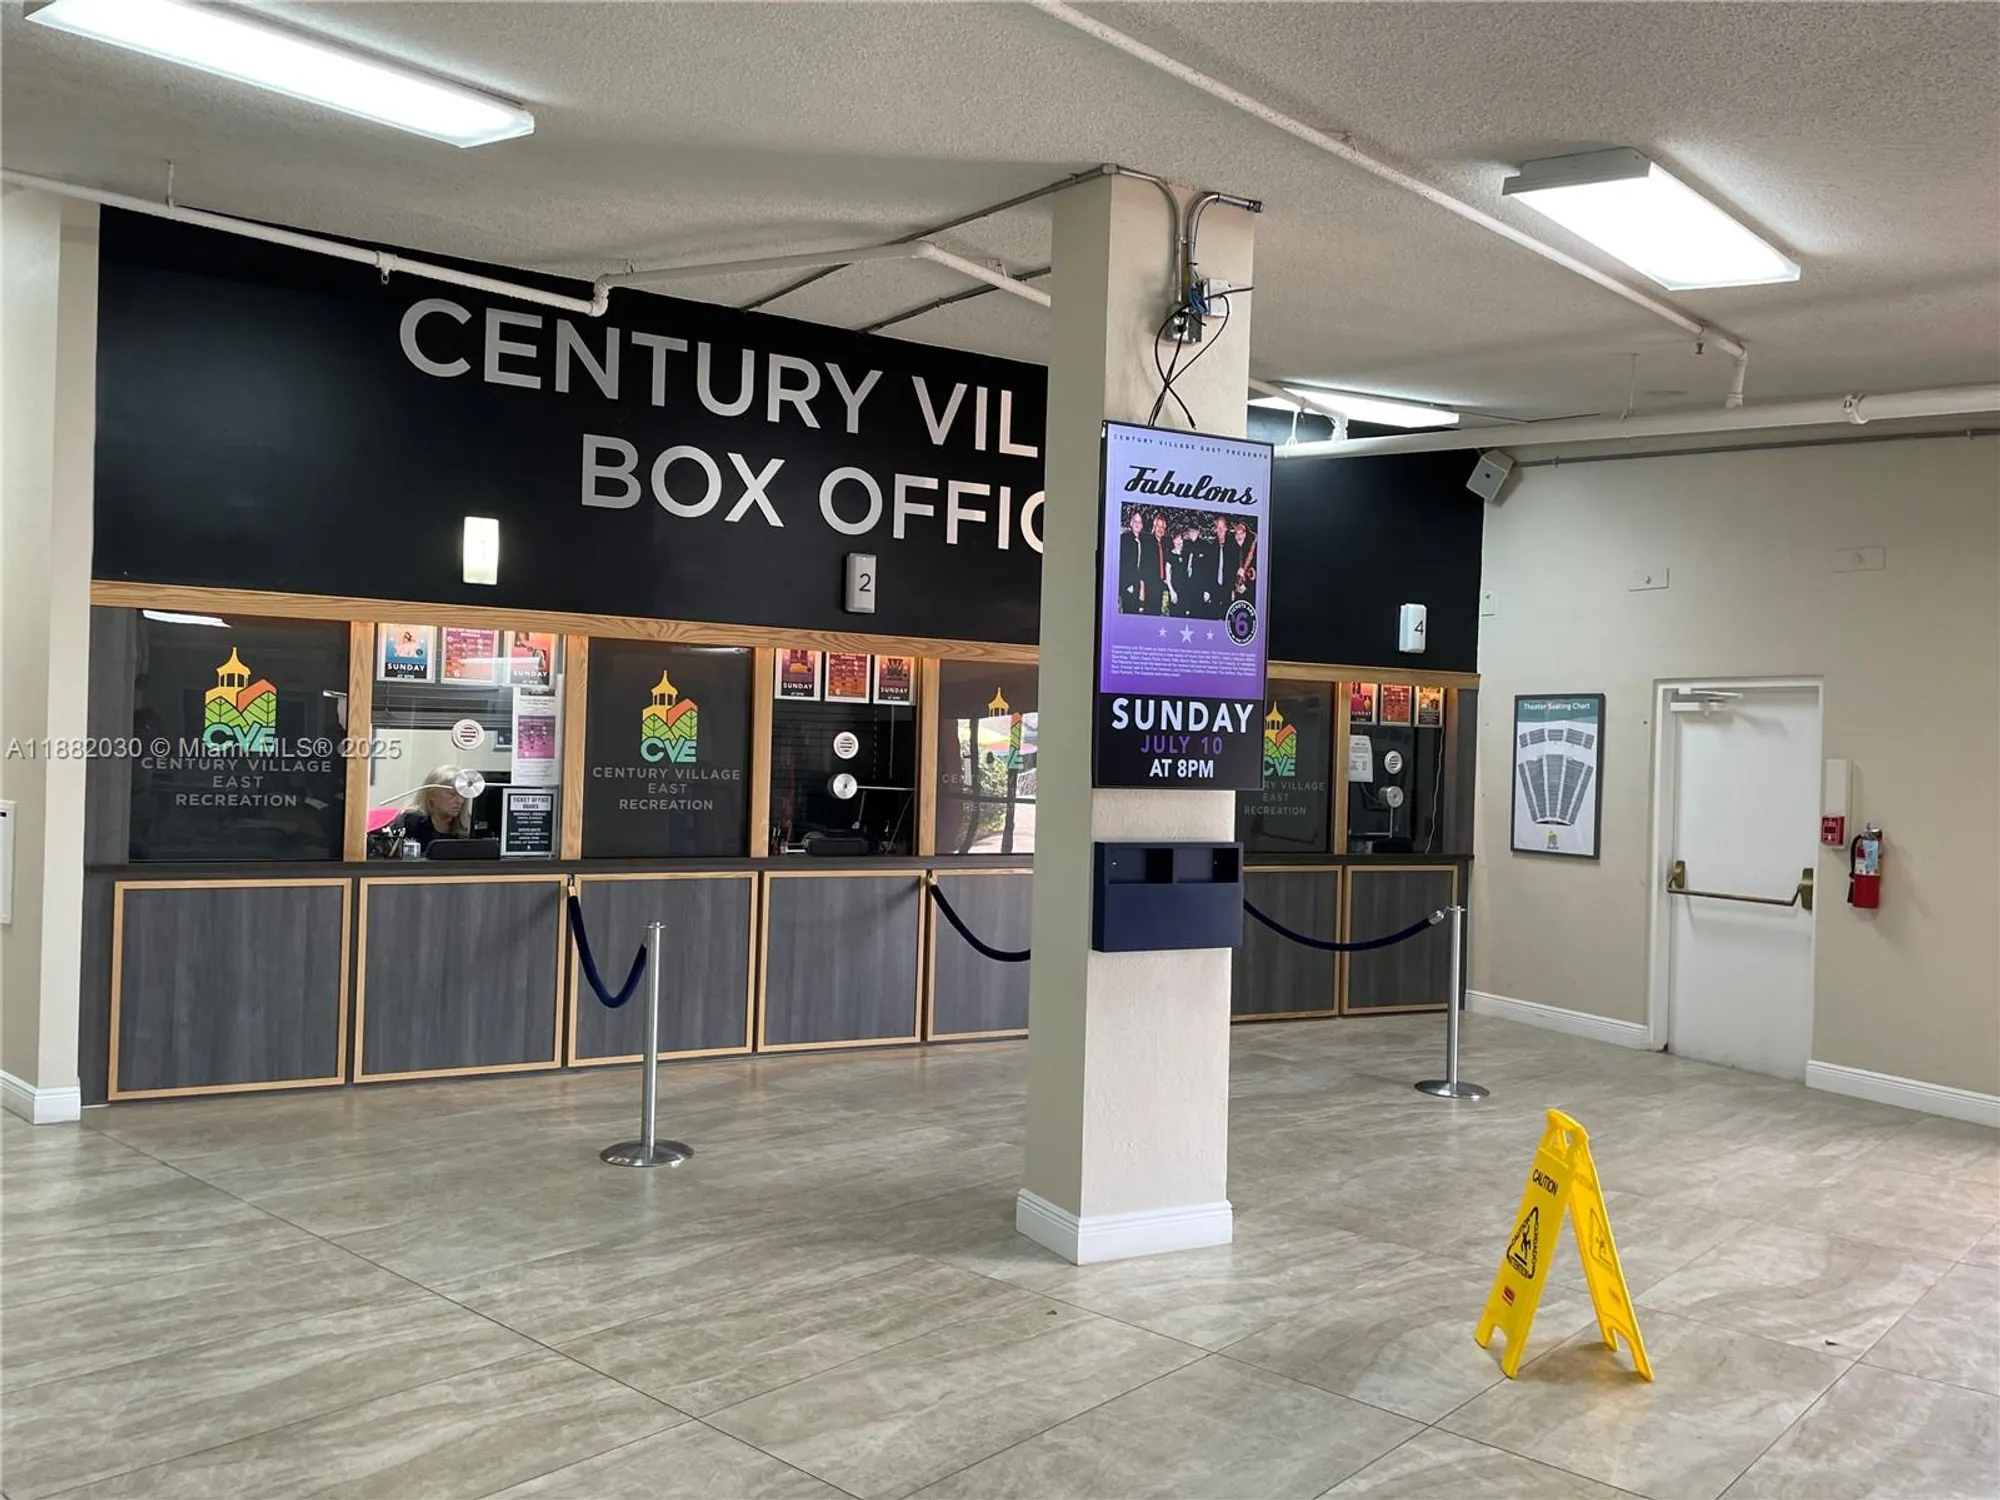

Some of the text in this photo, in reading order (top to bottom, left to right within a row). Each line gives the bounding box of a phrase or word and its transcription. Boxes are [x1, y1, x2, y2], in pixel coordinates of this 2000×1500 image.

[398, 297, 1039, 458] CENTURY VIL
[1158, 440, 1197, 451] VILLAGE
[1200, 445, 1221, 453] EAST
[1124, 465, 1257, 505] Fabulons
[581, 433, 1047, 556] BOX OFFIC
[859, 573, 871, 593] 2
[1414, 620, 1424, 636] 4
[387, 662, 425, 672] SUNDAY
[512, 669, 549, 678] SUNDAY
[783, 682, 813, 690] SUNDAY
[880, 686, 908, 694] SUNDAY
[1547, 703, 1571, 711] Seating
[1573, 702, 1590, 710] Chart
[1112, 697, 1254, 733] SUNDAY
[202, 721, 275, 753] CVE
[640, 736, 698, 763] CVE
[1141, 734, 1223, 756] JULY 10
[141, 756, 332, 773] CENTURY VILLAGE
[1149, 759, 1214, 779] AT 8PM
[1264, 754, 1296, 777] CVE
[592, 766, 741, 780] CENTURY VILLAGE
[213, 776, 264, 789] EAST
[647, 782, 688, 794] EAST
[1281, 781, 1326, 791] VILLAGE
[175, 793, 298, 808] RECREATION
[1263, 792, 1289, 802] EAST
[619, 799, 713, 811] RECREATION
[1243, 805, 1307, 816] RECREATION
[1532, 1168, 1559, 1197] CAUTION
